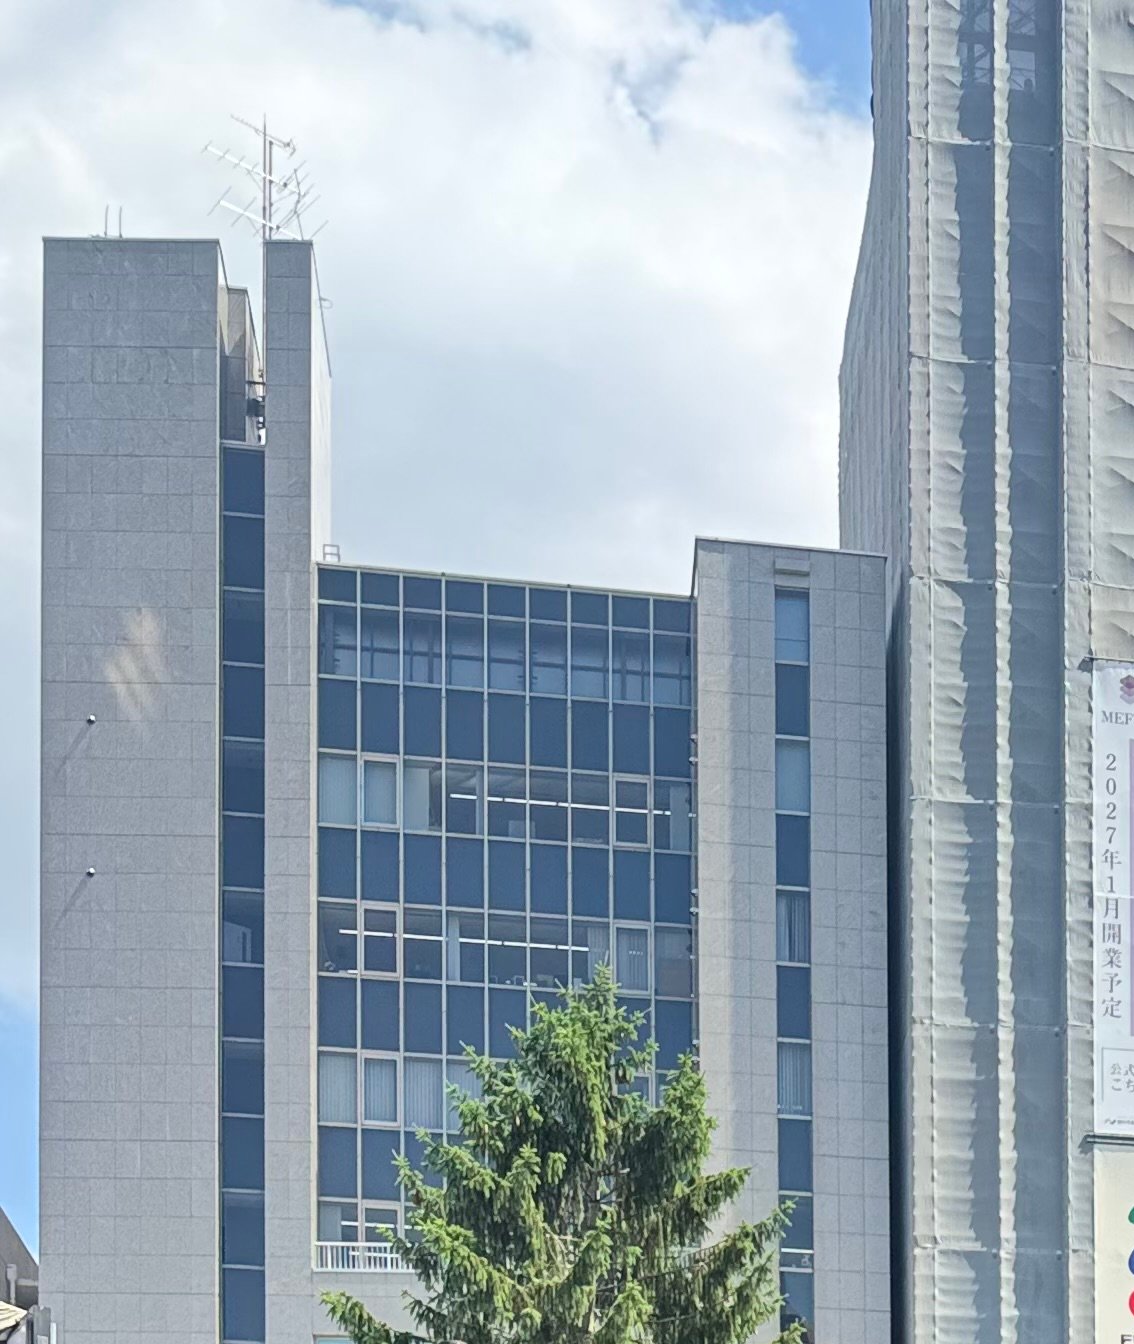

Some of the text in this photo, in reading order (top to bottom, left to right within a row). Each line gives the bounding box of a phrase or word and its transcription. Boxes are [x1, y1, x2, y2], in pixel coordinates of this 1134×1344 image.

[1101, 753, 1122, 1020] 2027年1月開業予定
